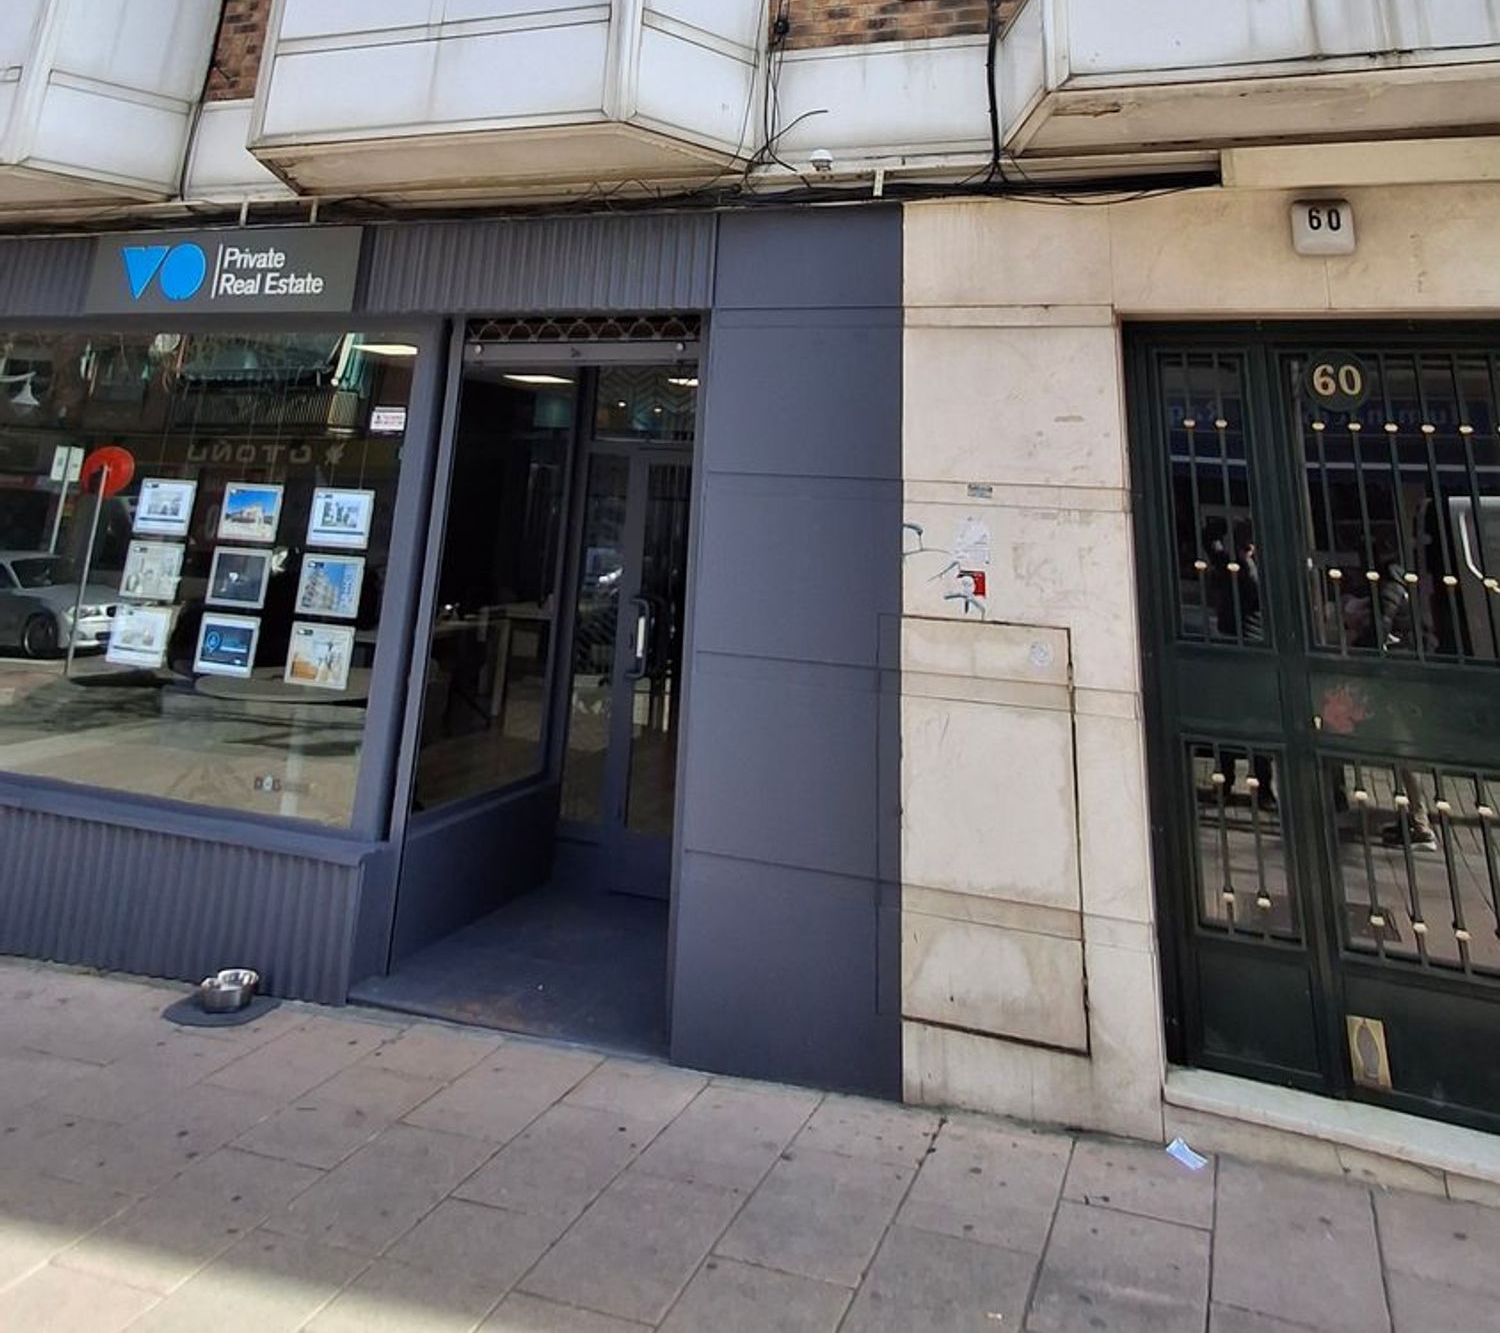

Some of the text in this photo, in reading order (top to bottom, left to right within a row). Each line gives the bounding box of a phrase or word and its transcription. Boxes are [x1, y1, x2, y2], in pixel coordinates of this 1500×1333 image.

[1307, 206, 1341, 231] 60
[222, 247, 286, 269] Private
[218, 273, 324, 296] Real Estate
[1312, 364, 1362, 396] 60
